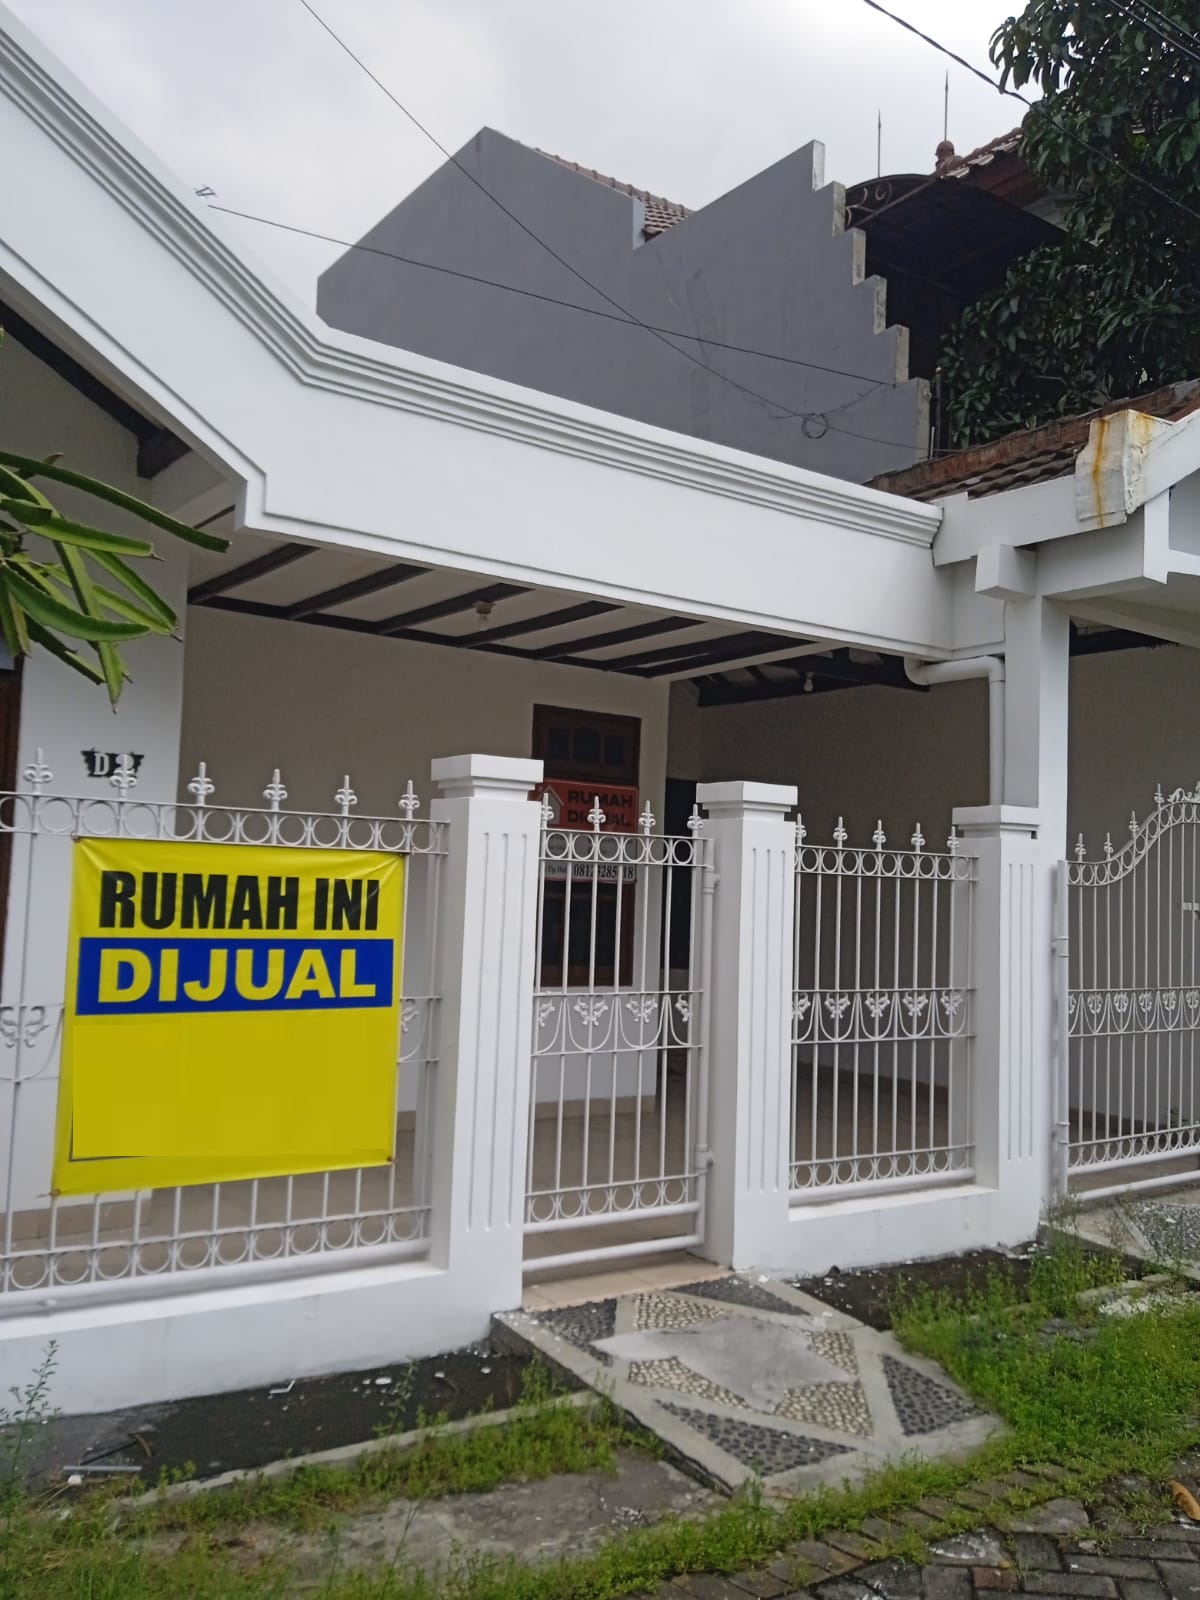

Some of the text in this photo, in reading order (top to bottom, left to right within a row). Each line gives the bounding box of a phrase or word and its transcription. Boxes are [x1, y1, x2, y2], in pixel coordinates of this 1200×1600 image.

[567, 790, 633, 808] RUMAH
[567, 809, 632, 827] DIAL
[98, 870, 380, 931] RUMAH INI
[97, 948, 377, 1004] DIJUAL
